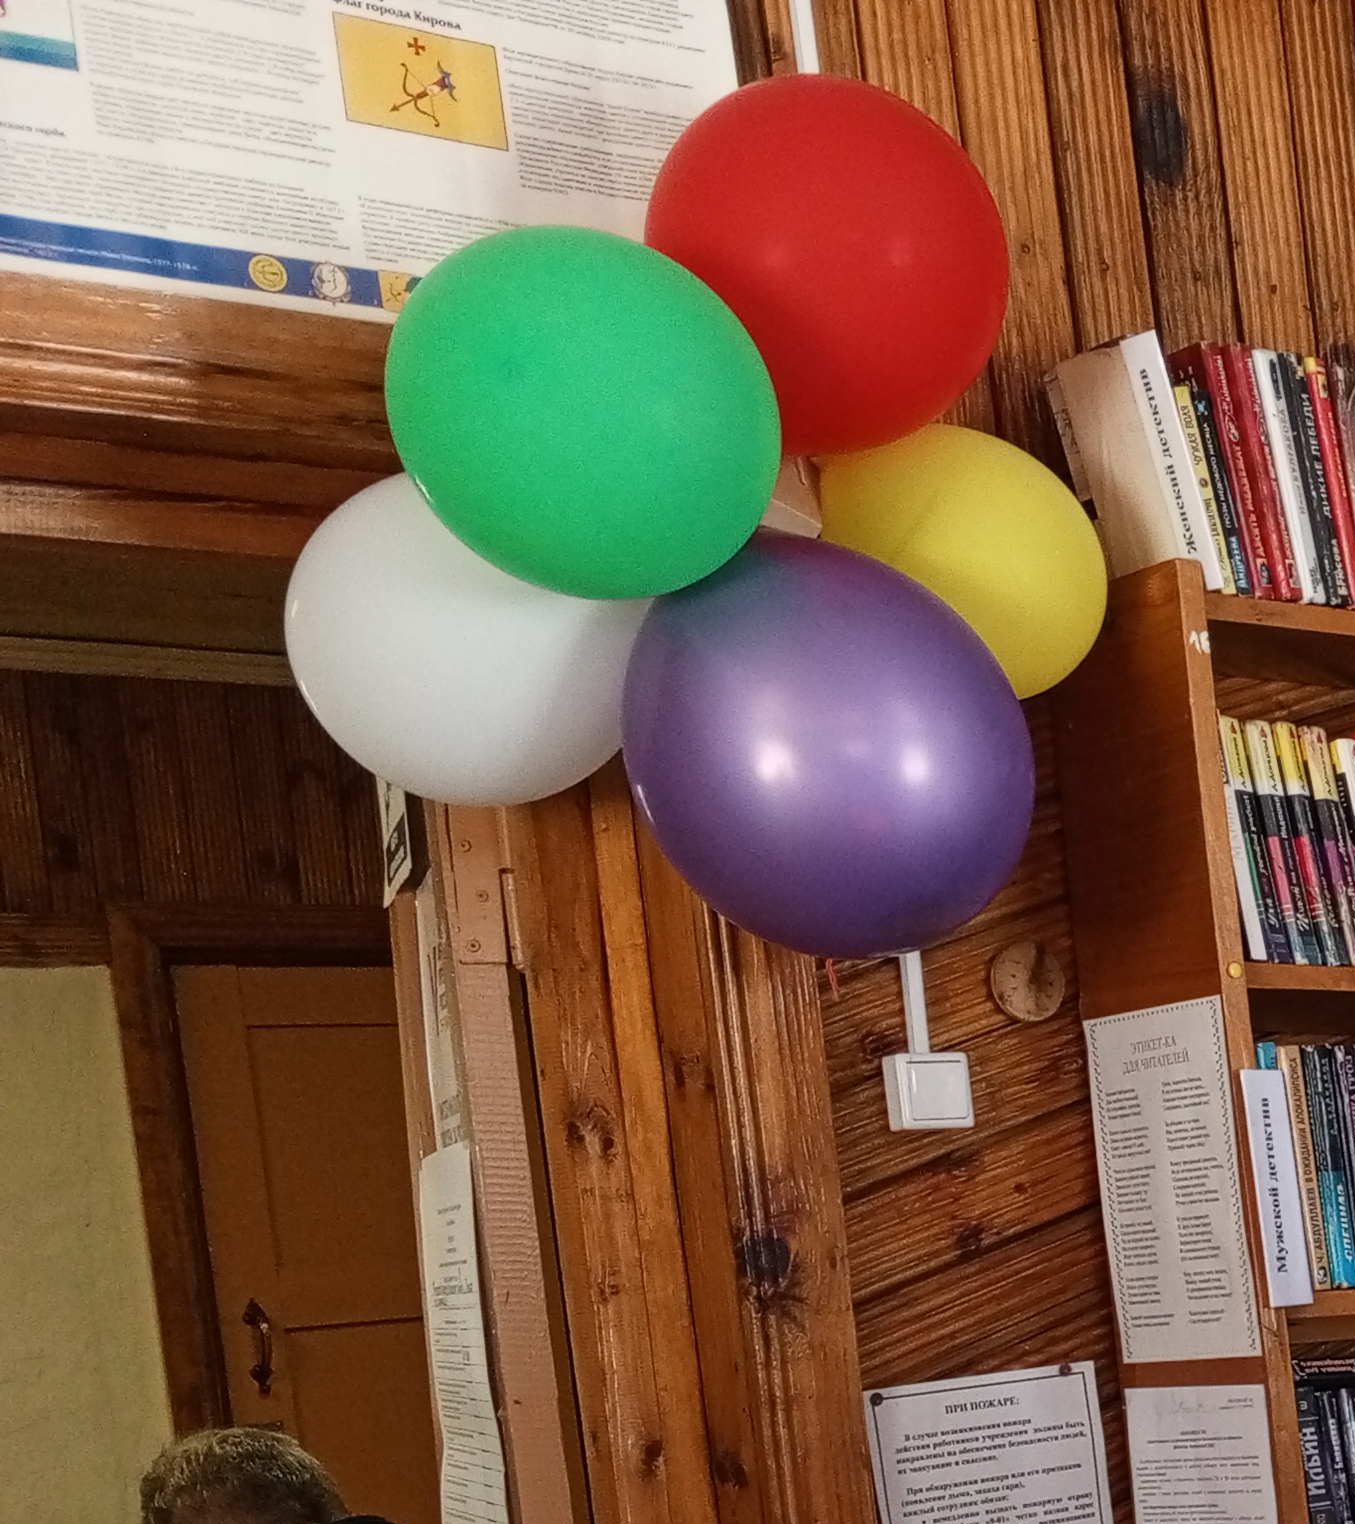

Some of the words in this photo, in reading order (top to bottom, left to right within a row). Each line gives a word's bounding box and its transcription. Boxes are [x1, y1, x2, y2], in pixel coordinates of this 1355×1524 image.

[365, 2, 411, 19] города
[414, 9, 462, 31] Кирова
[1139, 368, 1173, 459] детектив
[1301, 393, 1320, 457] ЛЕБЕДИ
[1165, 464, 1198, 554] Женский
[1316, 459, 1332, 518] ДИКИЕ
[1261, 1097, 1279, 1181] детектив
[1258, 1182, 1289, 1274] Мужской
[1306, 1188, 1324, 1250] АБДУЛЛАЕВ
[945, 1403, 969, 1415] ПРИ
[970, 1397, 1020, 1411] ПОЖАРЕ:
